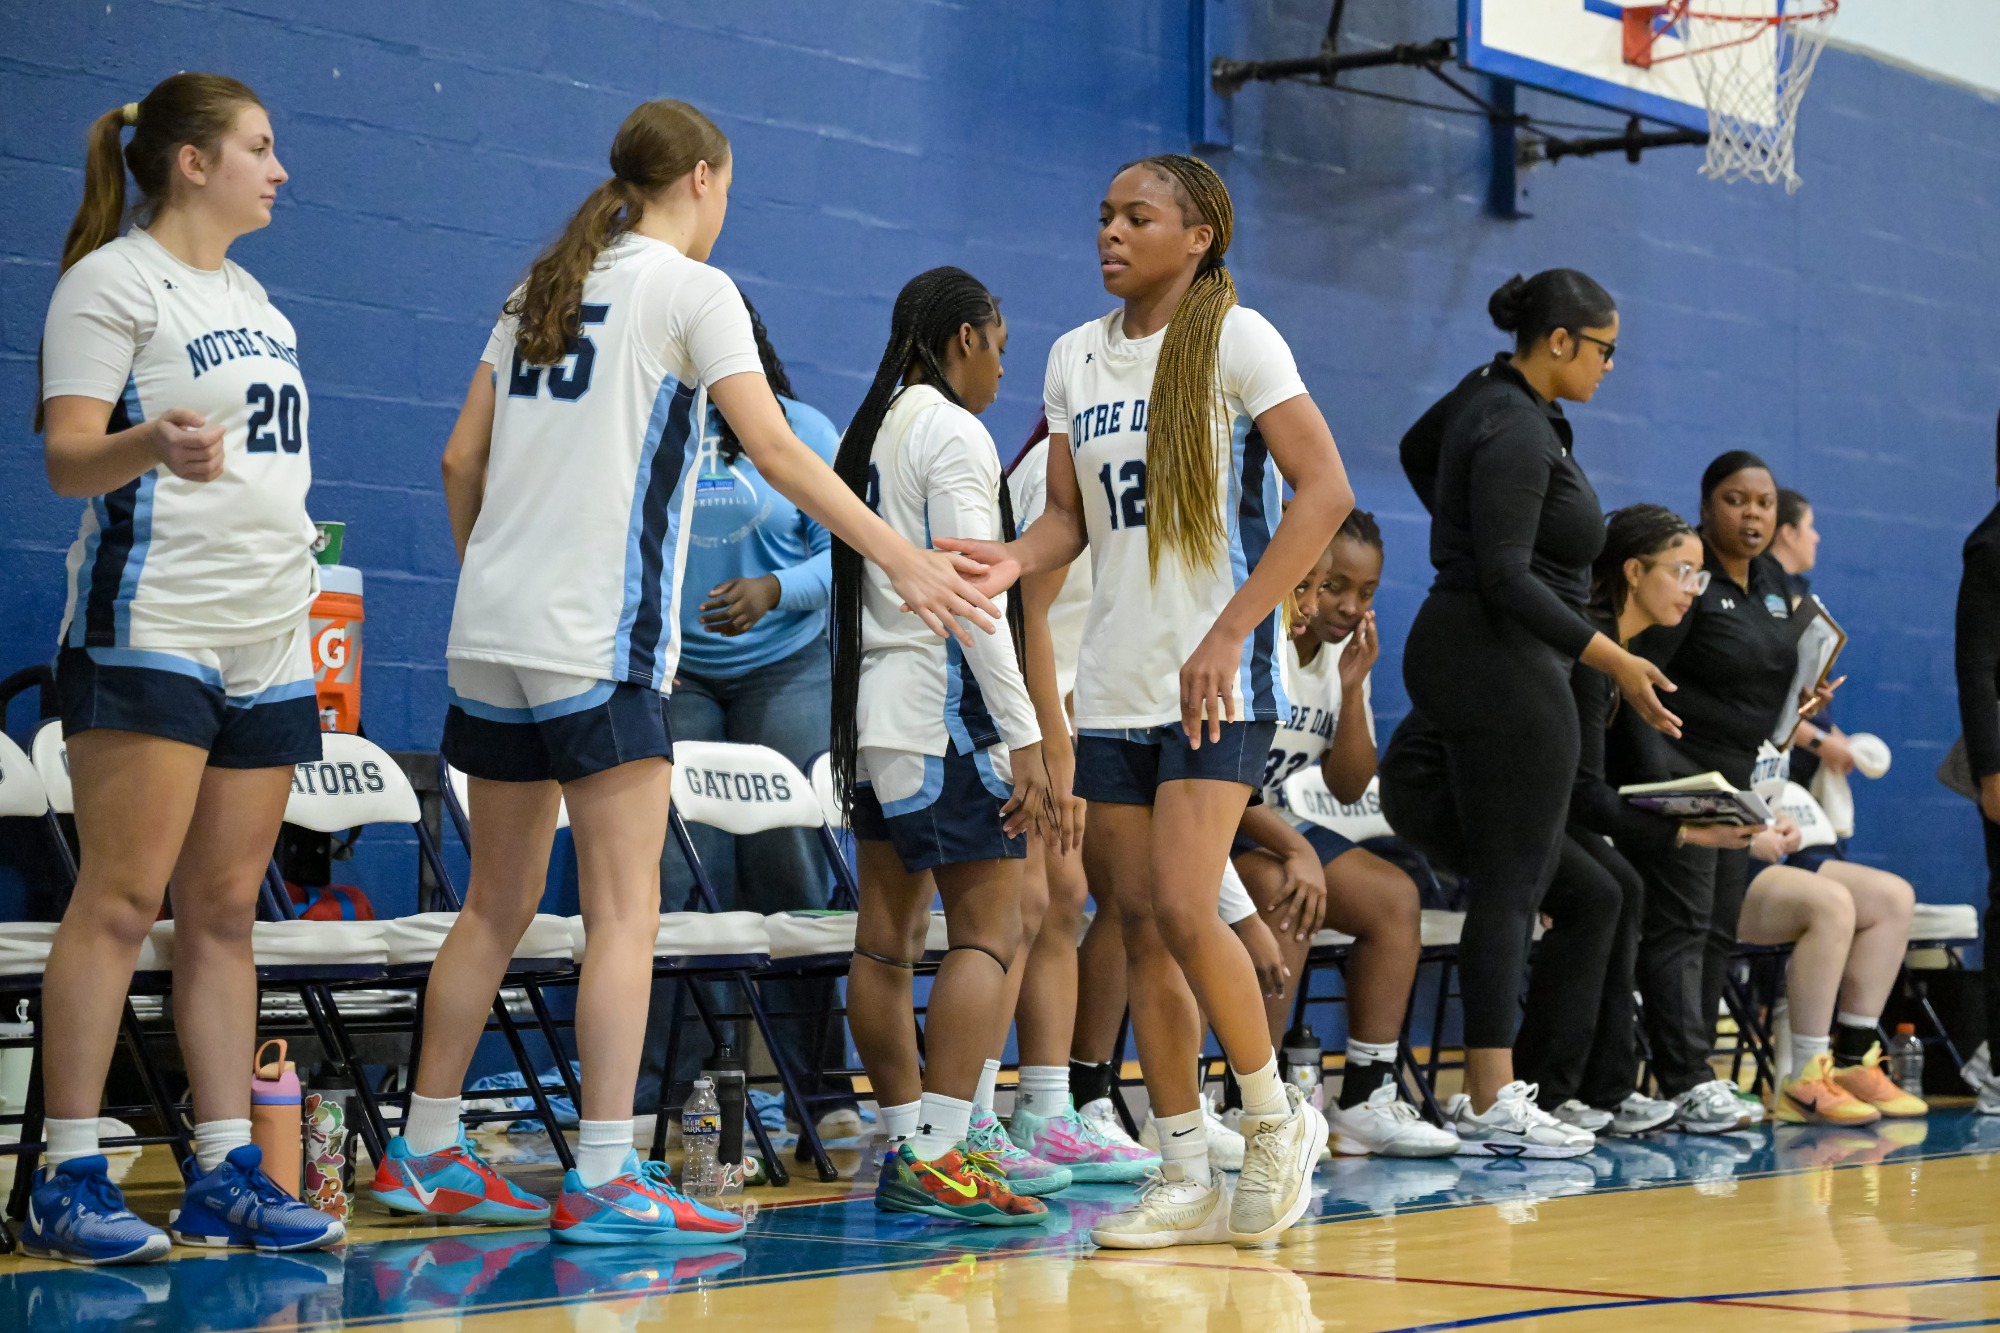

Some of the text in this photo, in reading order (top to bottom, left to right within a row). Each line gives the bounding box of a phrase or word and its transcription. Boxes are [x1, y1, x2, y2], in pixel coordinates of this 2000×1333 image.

[185, 327, 262, 379] NOTRE
[245, 381, 302, 454] 20
[1098, 458, 1147, 531] 12
[318, 627, 345, 669] G
[684, 766, 793, 802] GATORS
